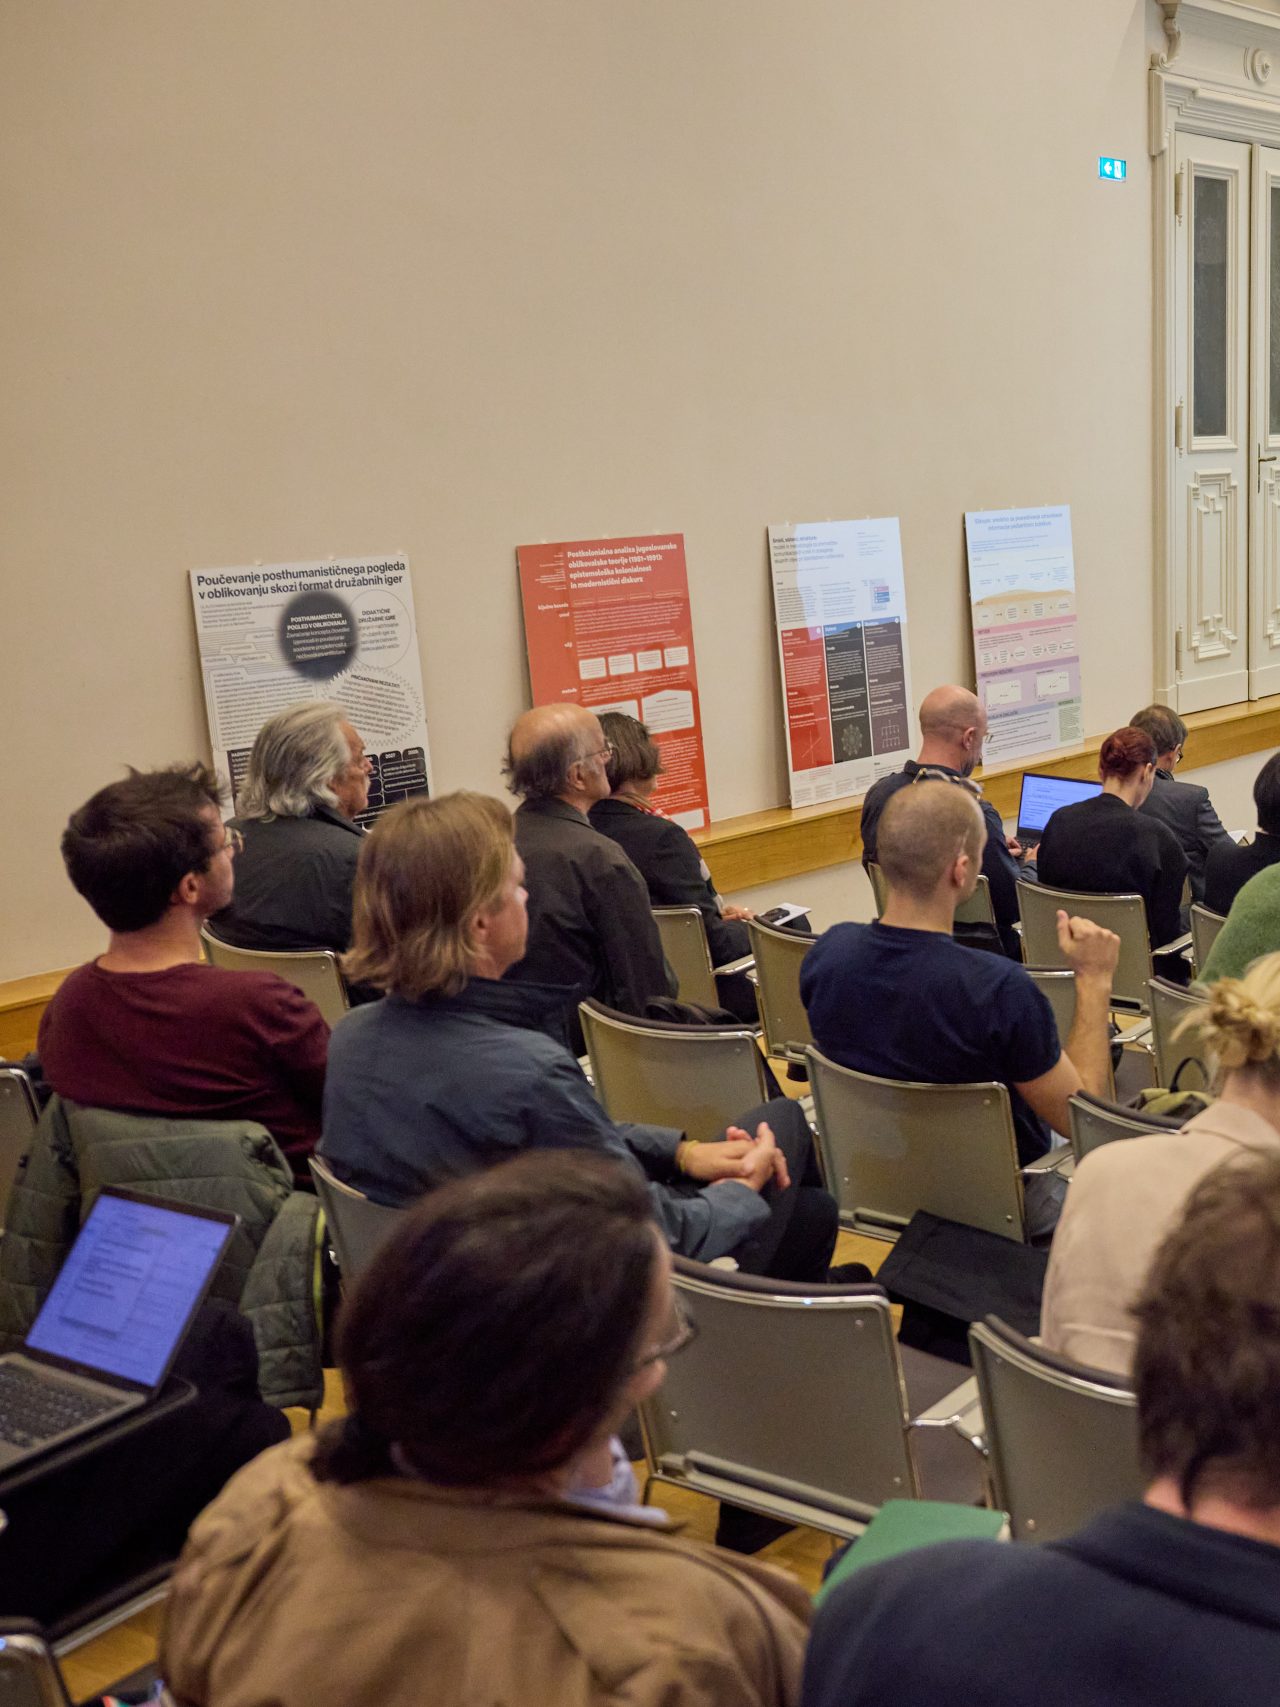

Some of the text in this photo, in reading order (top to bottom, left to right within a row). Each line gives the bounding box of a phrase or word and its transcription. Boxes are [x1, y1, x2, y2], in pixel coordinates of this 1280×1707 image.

[197, 561, 405, 586] Poučevanje posthumanističnega pogleda
[199, 574, 403, 599] v oblikovanju skozi format družabnih iger
